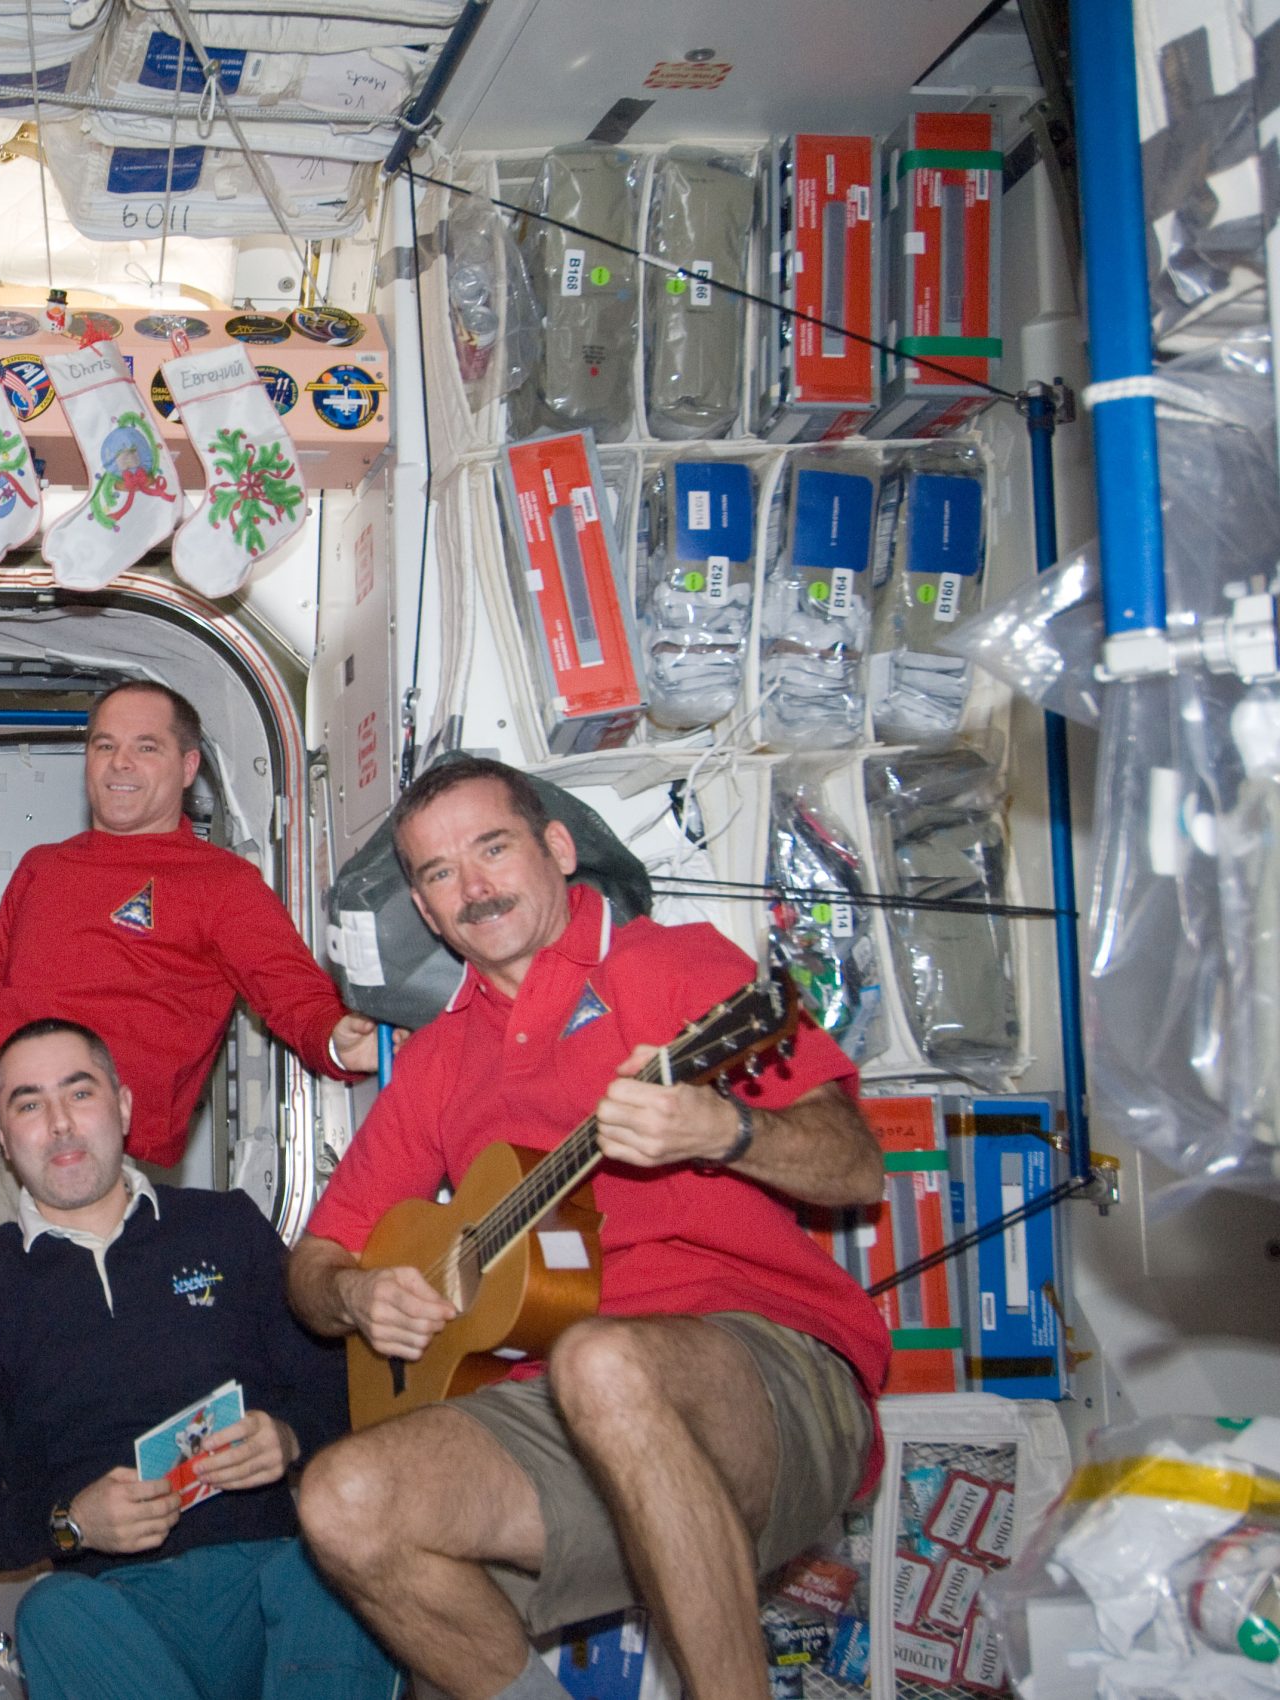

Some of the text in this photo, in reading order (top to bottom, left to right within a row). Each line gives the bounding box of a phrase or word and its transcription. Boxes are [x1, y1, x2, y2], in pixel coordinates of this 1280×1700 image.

[567, 257, 581, 290] B168
[70, 359, 112, 379] Chris
[181, 360, 245, 390] Евгений
[276, 378, 290, 390] 11
[695, 496, 704, 526] 1/31/14
[710, 564, 723, 598] B162
[834, 575, 848, 608] B164
[939, 580, 954, 614] B160
[836, 894, 849, 928] 114
[946, 1487, 980, 1538] ALTOIDS
[783, 1626, 826, 1642] Dentyne
[802, 1639, 822, 1651] Ice
[980, 1633, 998, 1680] TOIDS
